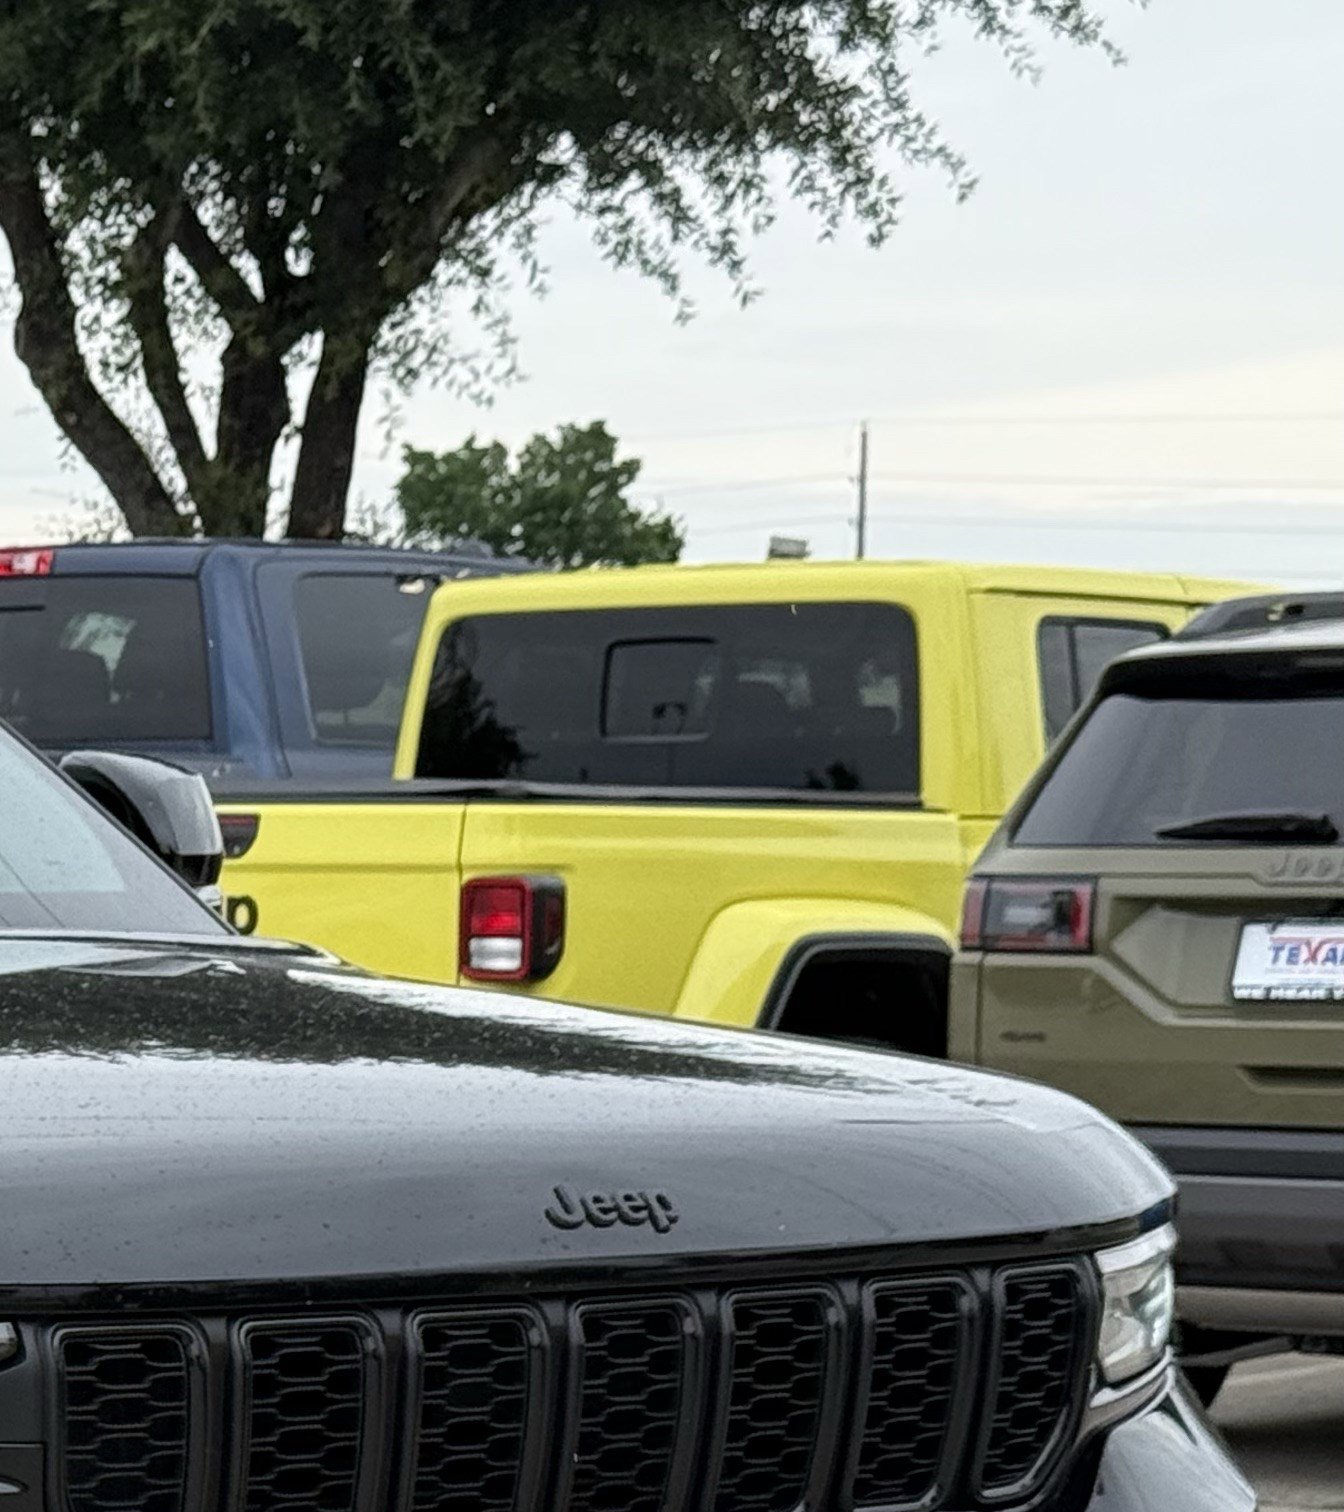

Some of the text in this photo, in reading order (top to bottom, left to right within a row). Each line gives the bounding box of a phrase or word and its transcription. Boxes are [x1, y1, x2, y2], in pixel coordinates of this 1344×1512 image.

[1268, 849, 1344, 878] Jee
[1269, 939, 1344, 967] TEXA
[544, 1184, 679, 1234] Jeep
